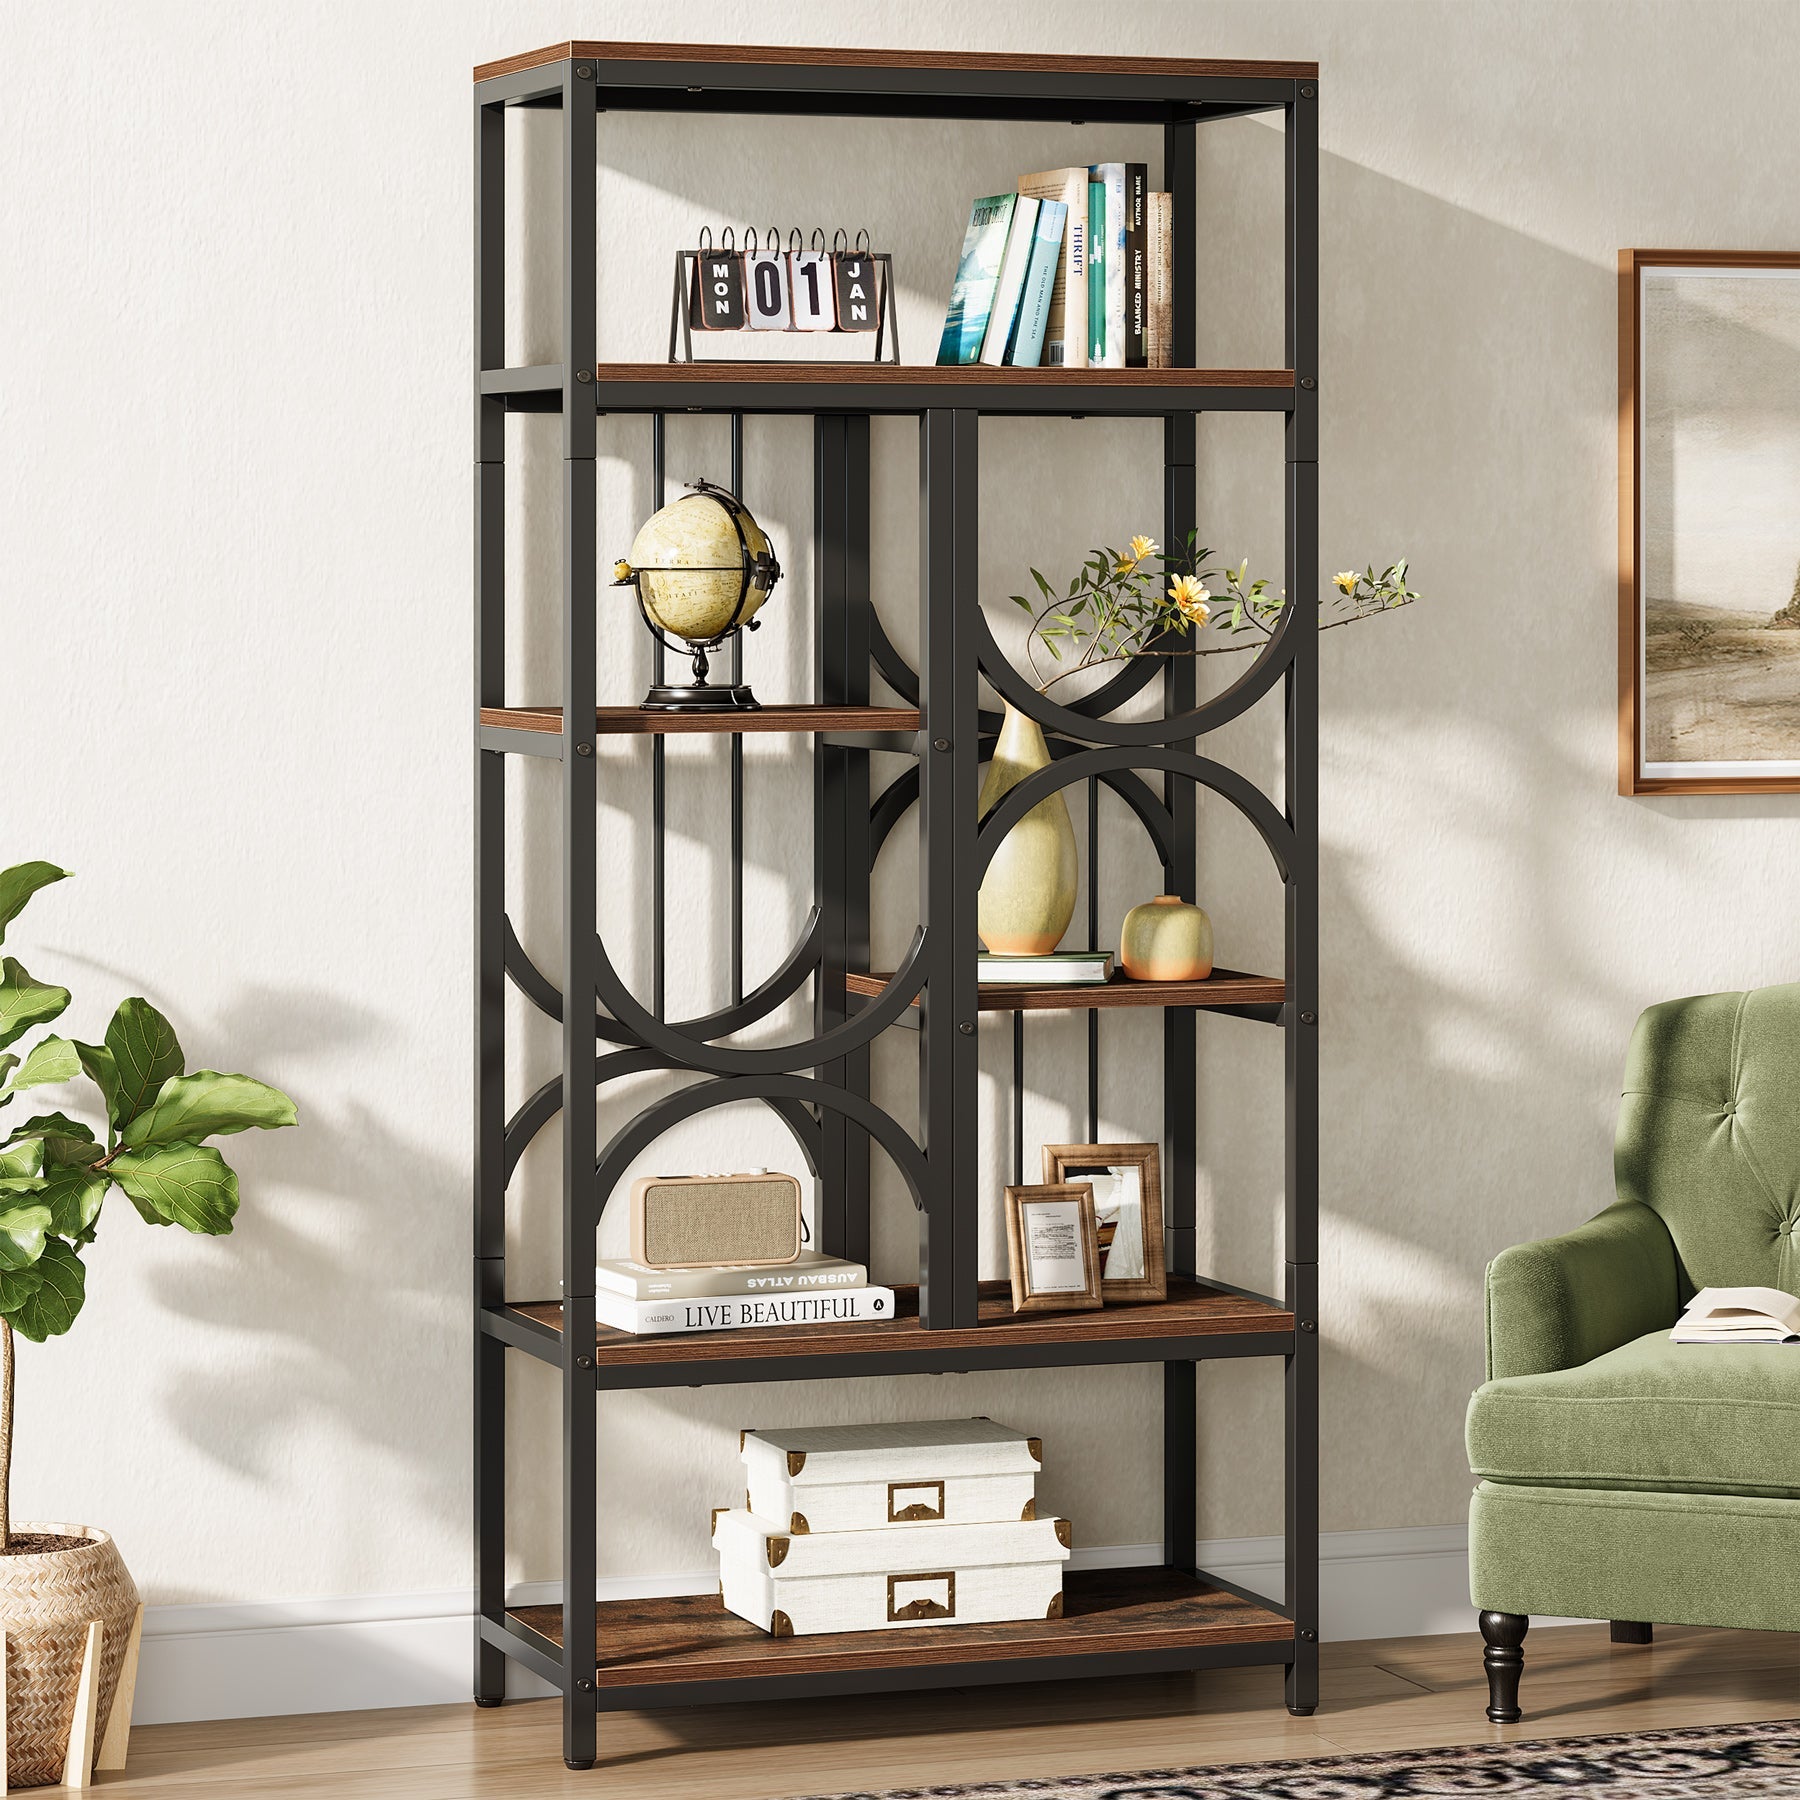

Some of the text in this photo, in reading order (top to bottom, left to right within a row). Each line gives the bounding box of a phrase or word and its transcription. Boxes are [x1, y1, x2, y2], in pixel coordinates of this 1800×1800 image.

[1073, 224, 1083, 276] THRIFT
[713, 264, 730, 314] MON
[754, 261, 821, 317] 01
[847, 262, 867, 321] JAN
[1134, 249, 1142, 335] BALANCED MINISTRY
[747, 1272, 858, 1288] AUSBAU ATLAS
[645, 1297, 860, 1328] CALDERO LIVE BEAUTIFUL
